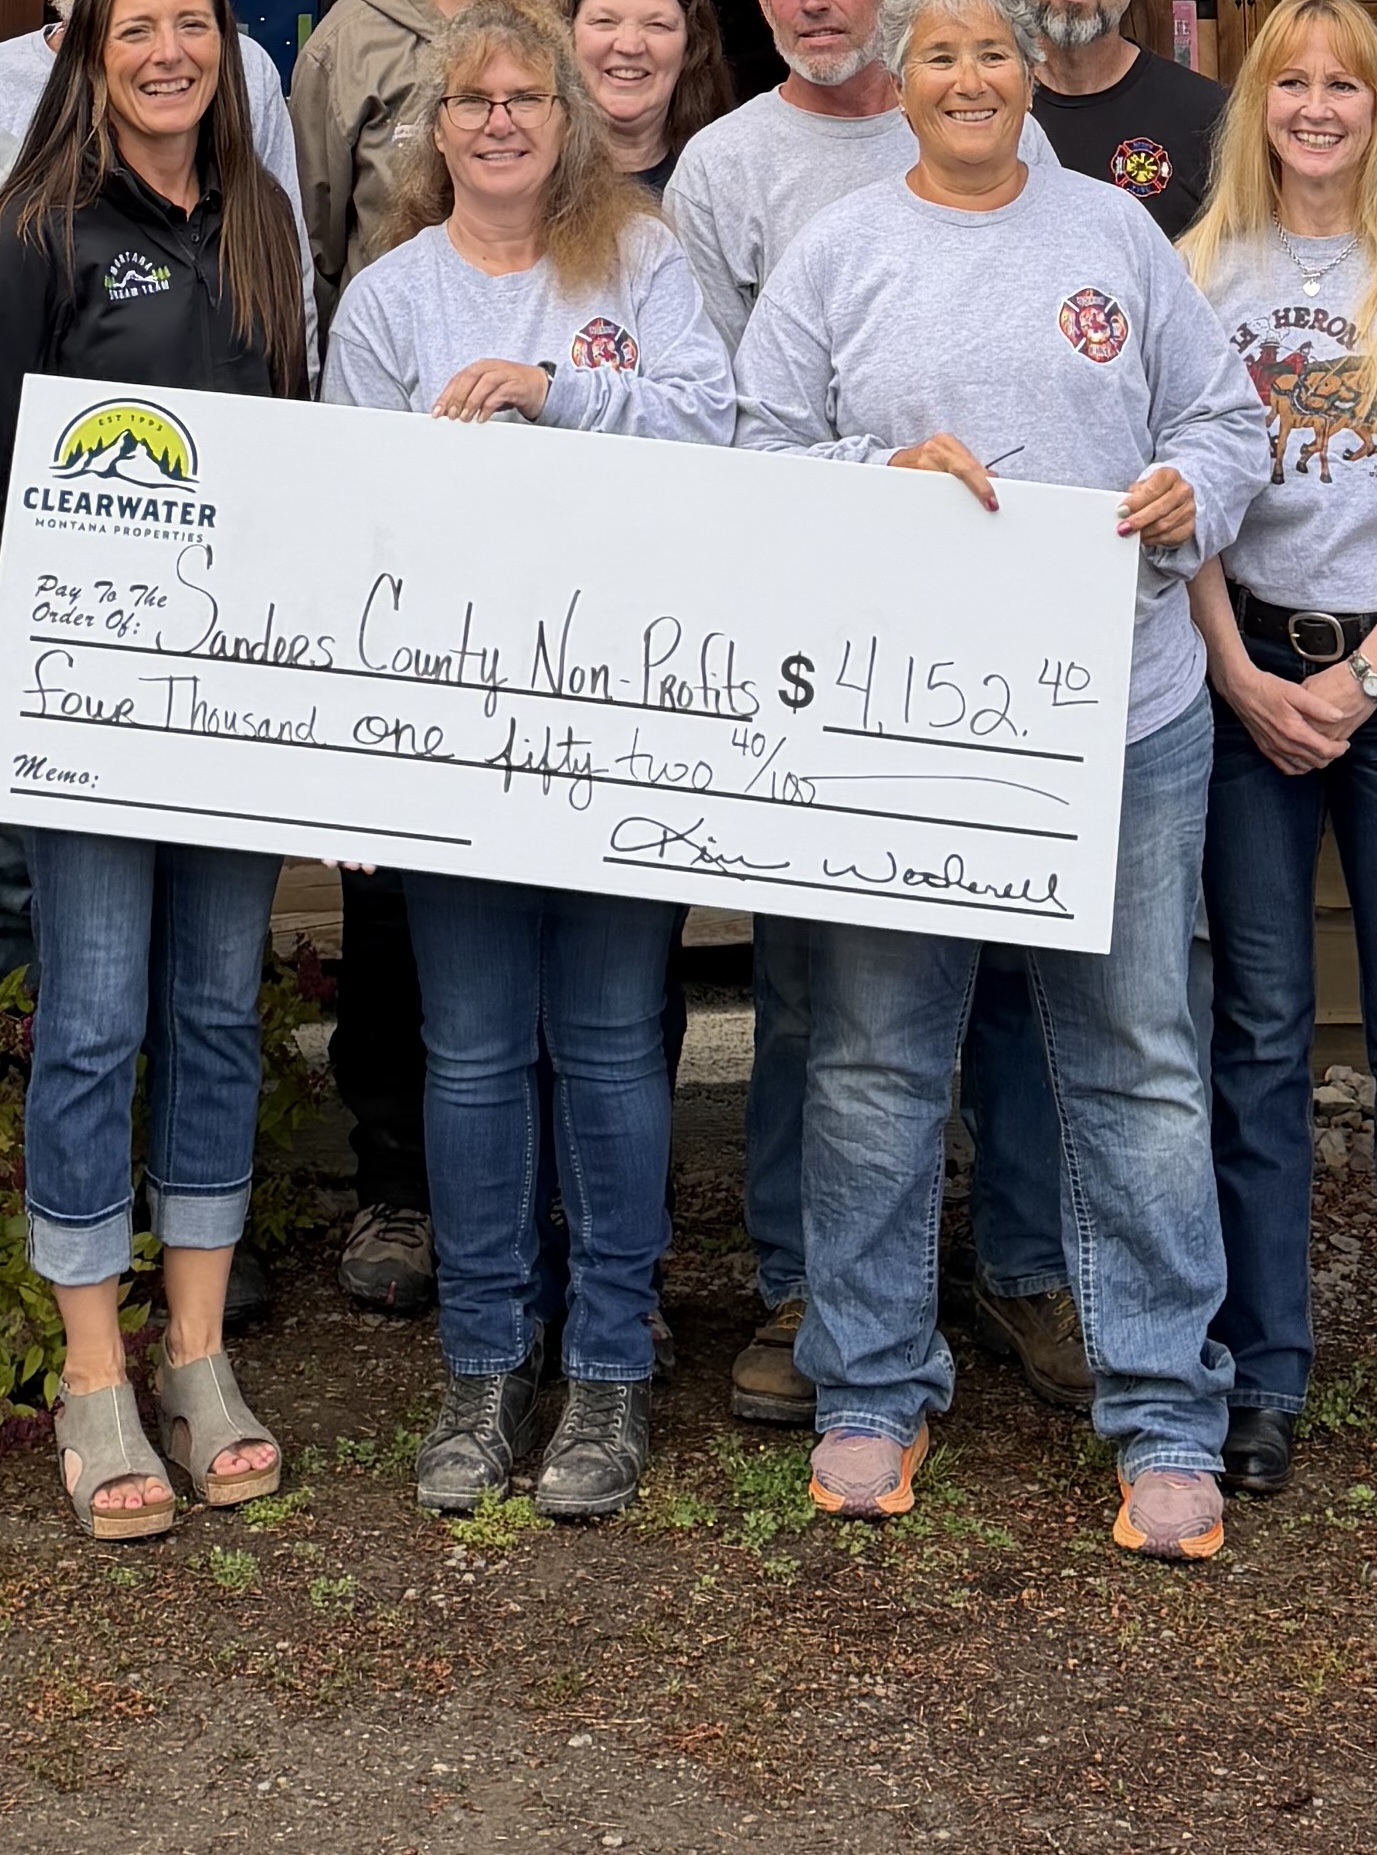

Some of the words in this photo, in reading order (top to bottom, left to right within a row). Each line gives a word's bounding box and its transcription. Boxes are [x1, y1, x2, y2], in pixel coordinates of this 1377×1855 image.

[98, 413, 122, 427] EST
[22, 486, 217, 529] CLEARWATER
[35, 517, 108, 534] MONTANA
[113, 525, 205, 544] PROPERTIES
[34, 573, 82, 606] Pay
[94, 580, 118, 605] To
[128, 583, 169, 609] The
[31, 601, 96, 629] Order
[104, 610, 142, 638] Of:
[359, 573, 508, 717] County
[138, 673, 319, 746] Thousand
[484, 716, 609, 812] fifty
[614, 727, 714, 791] two
[10, 752, 101, 790] Memo:
